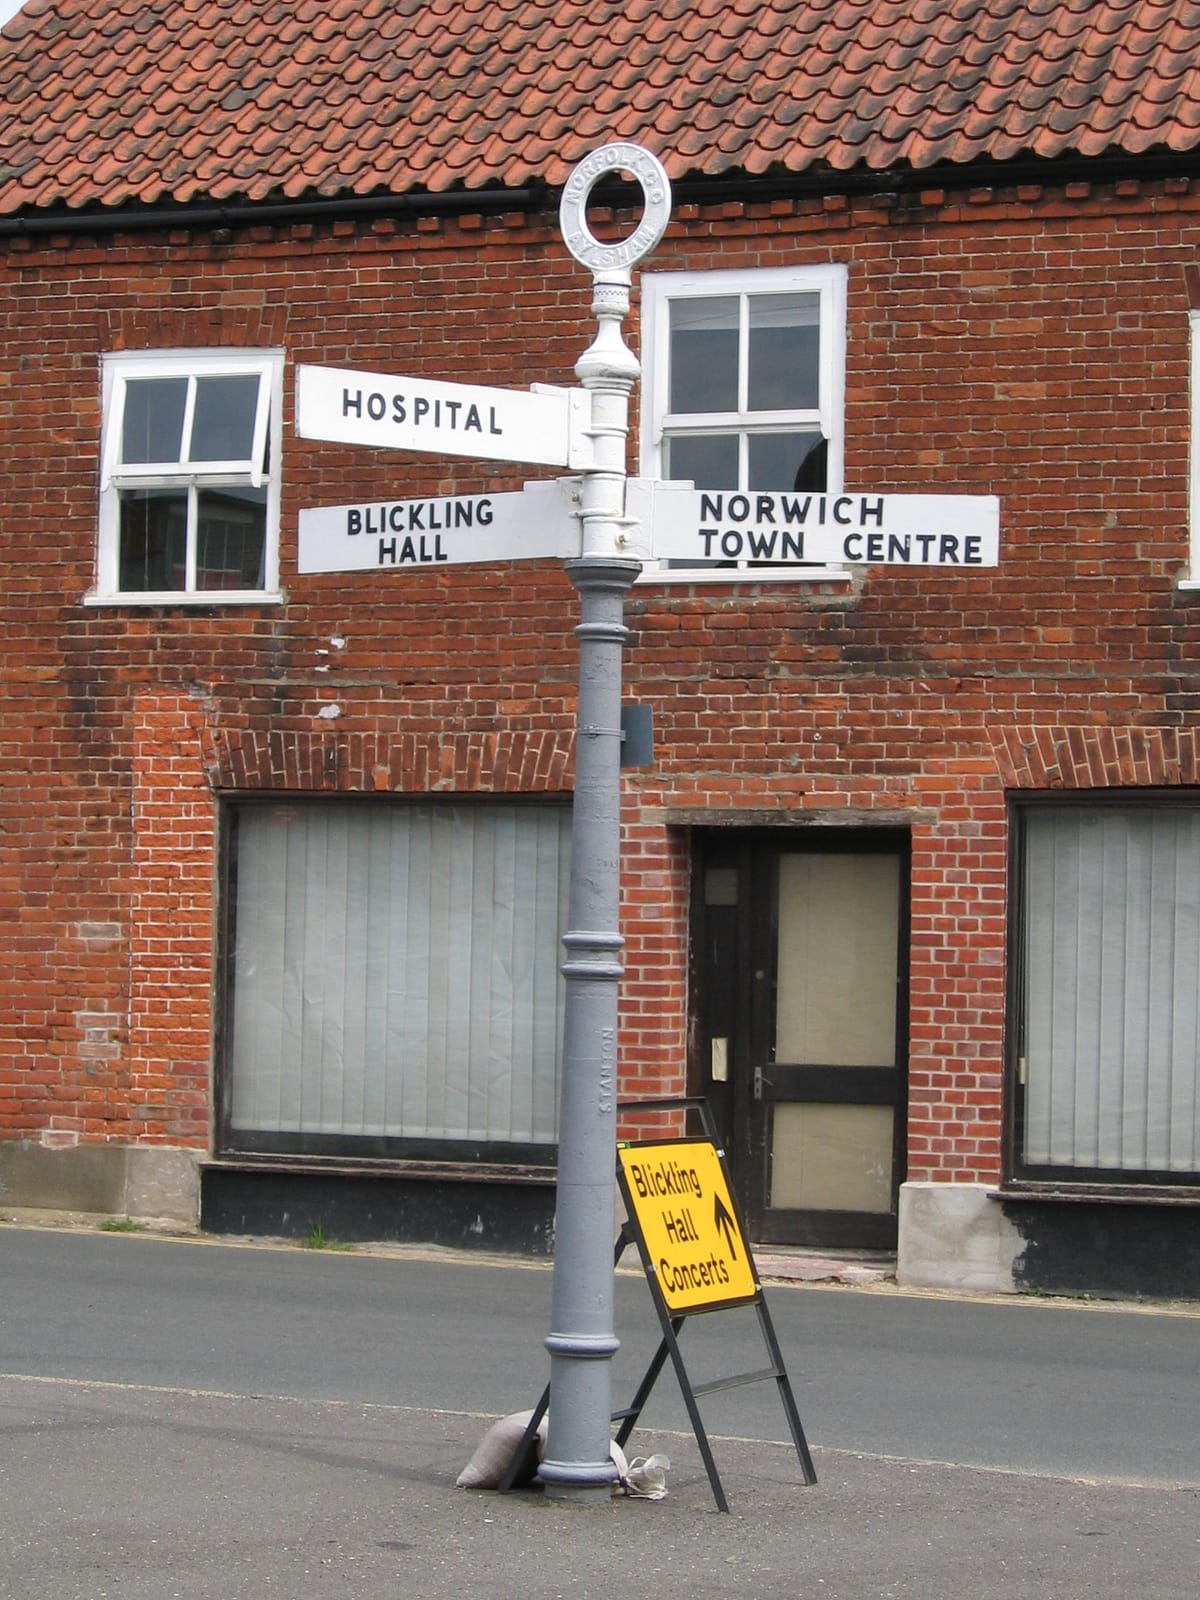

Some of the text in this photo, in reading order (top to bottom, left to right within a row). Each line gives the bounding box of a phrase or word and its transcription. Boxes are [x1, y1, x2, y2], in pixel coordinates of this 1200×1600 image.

[342, 388, 503, 435] HOSPITAL
[347, 499, 493, 536] BLICKLING
[700, 494, 884, 526] NORWICH
[379, 534, 448, 565] HALL
[698, 528, 982, 564] TOWN CENTRE
[630, 1160, 703, 1200] Blickling
[661, 1207, 700, 1245] Hall
[659, 1252, 730, 1294] Concerts
